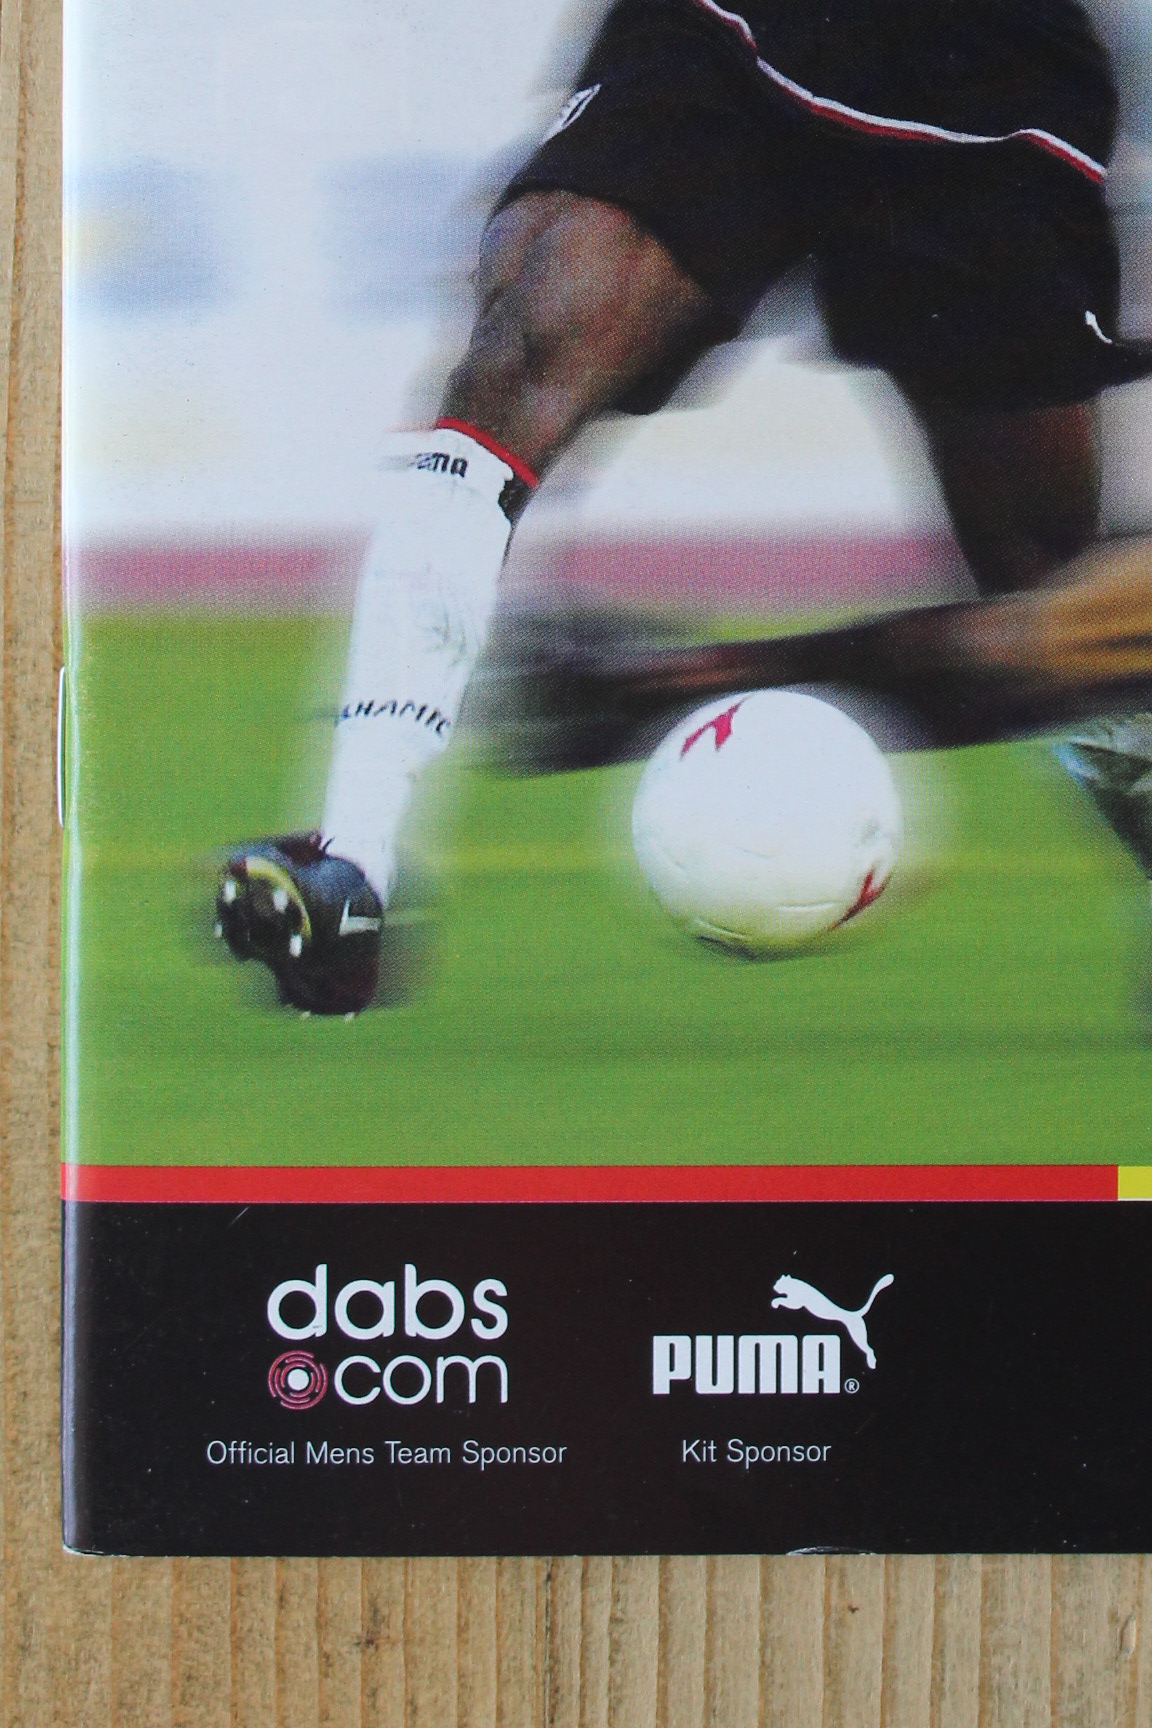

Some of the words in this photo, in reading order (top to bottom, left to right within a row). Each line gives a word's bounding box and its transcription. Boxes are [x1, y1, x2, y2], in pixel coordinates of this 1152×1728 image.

[266, 1263, 509, 1340] dabs
[206, 1440, 295, 1465] Official
[307, 1441, 375, 1465] Mens
[385, 1441, 451, 1465] Team
[462, 1440, 568, 1472] Sponsor
[682, 1439, 718, 1463] Kit
[726, 1438, 832, 1470] Sponsor
